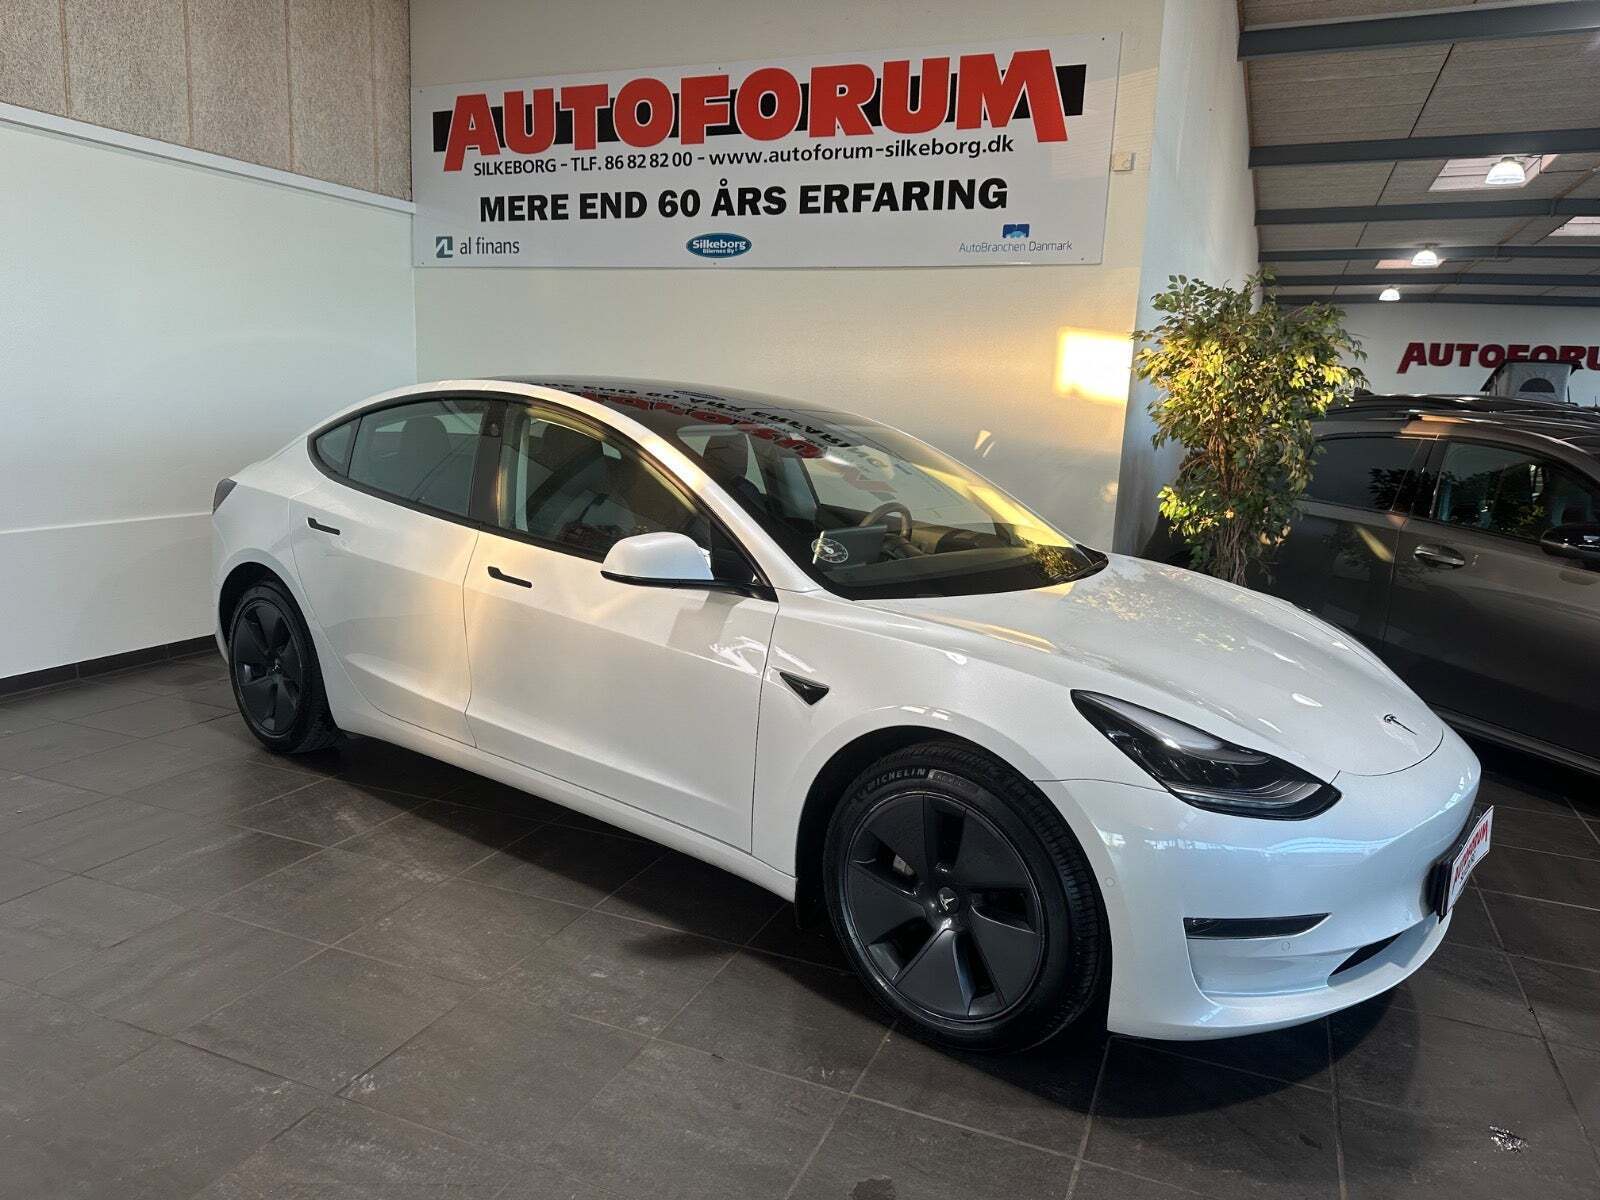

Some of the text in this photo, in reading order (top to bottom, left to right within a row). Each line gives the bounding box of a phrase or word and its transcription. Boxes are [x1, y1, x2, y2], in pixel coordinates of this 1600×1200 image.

[443, 48, 1069, 172] AUTOFORUM
[473, 158, 557, 177] SILKEBORG
[571, 157, 602, 172] TLF.
[604, 155, 624, 170] 86
[627, 154, 647, 169] 82
[649, 153, 669, 168] 82
[672, 152, 693, 167] 00
[708, 135, 1015, 166] www.autoforum-silkeborg.dk
[480, 177, 1008, 223] MERE END 60 ÅRS ERFARING
[460, 236, 520, 255] al finans
[692, 239, 747, 251] Silkeborg
[959, 240, 1073, 253] AutoBranchen Danmark
[866, 767, 927, 791] MICHELIN
